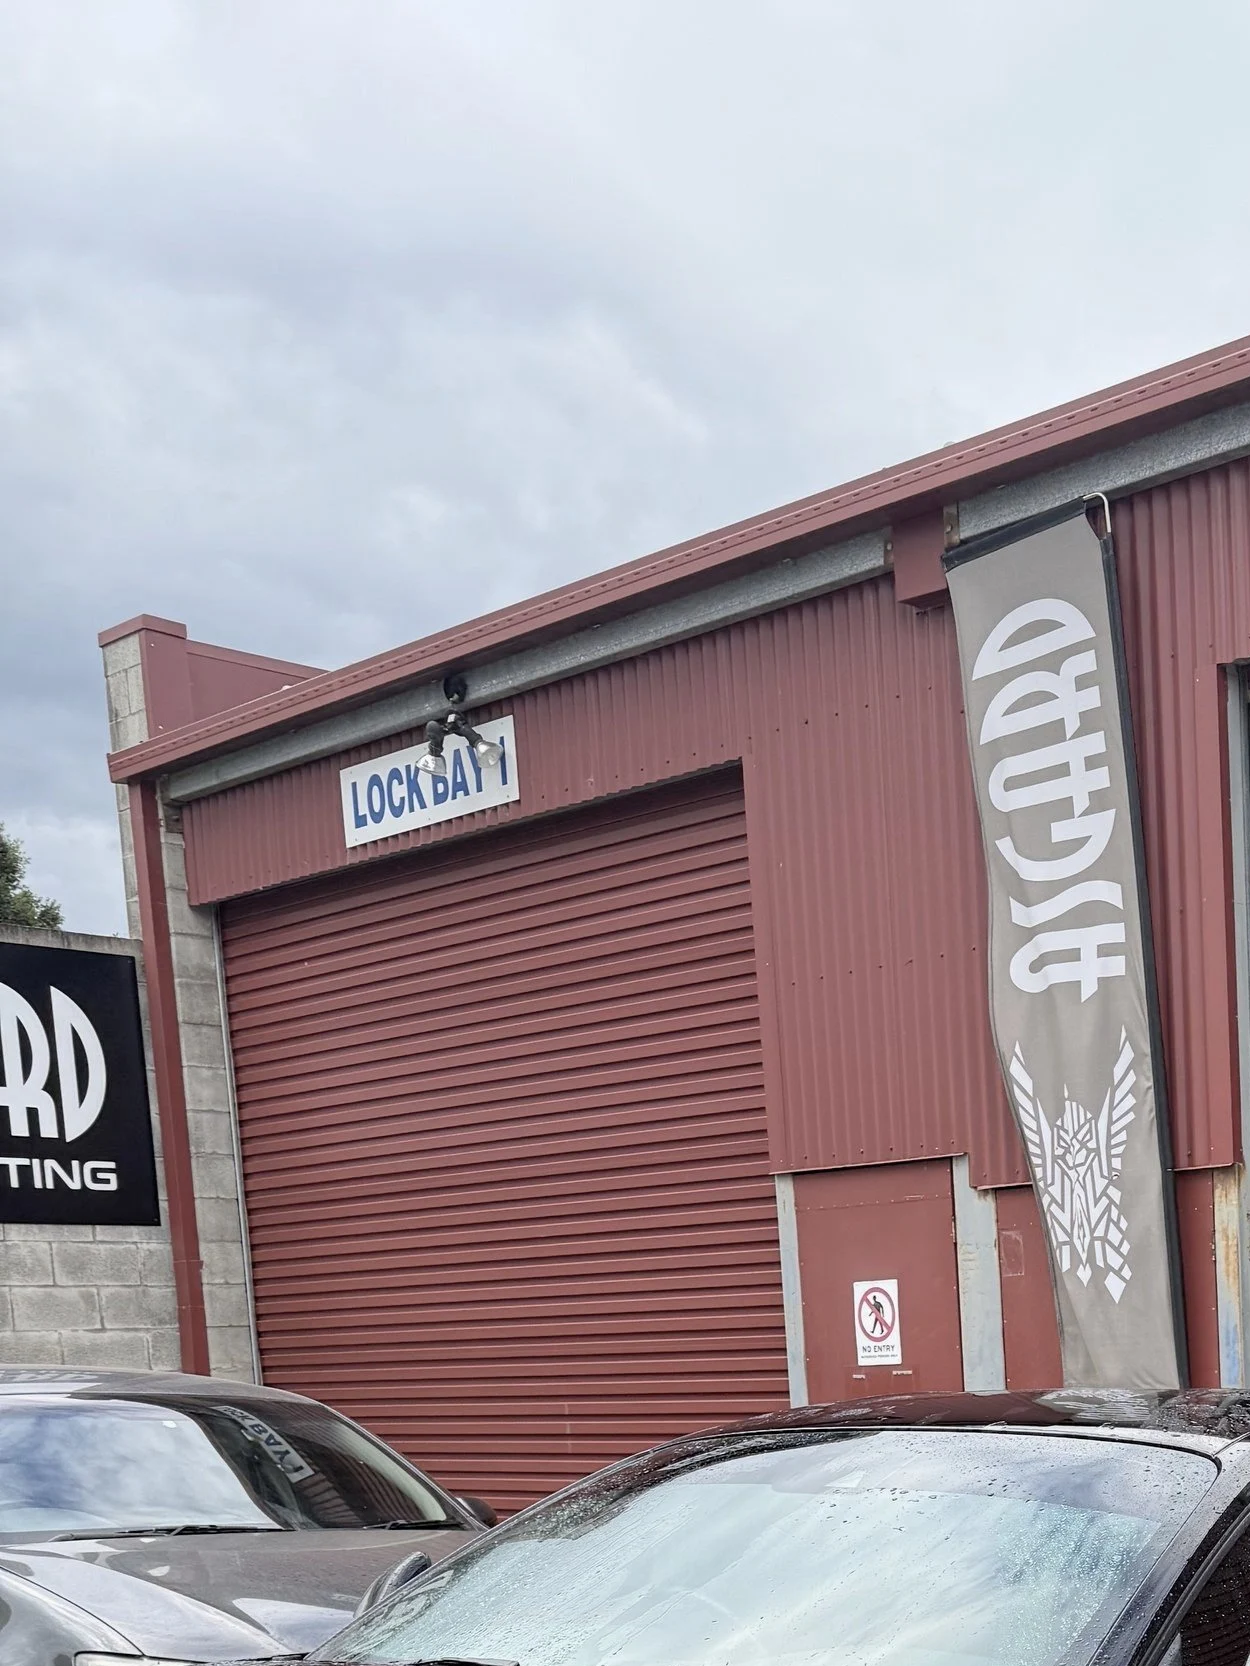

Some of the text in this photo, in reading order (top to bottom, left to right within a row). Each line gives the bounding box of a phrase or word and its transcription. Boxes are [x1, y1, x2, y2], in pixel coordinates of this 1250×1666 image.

[351, 764, 428, 829] LOCK
[972, 598, 1126, 1003] ASGARD
[862, 1344, 895, 1353] NO ENTRY
